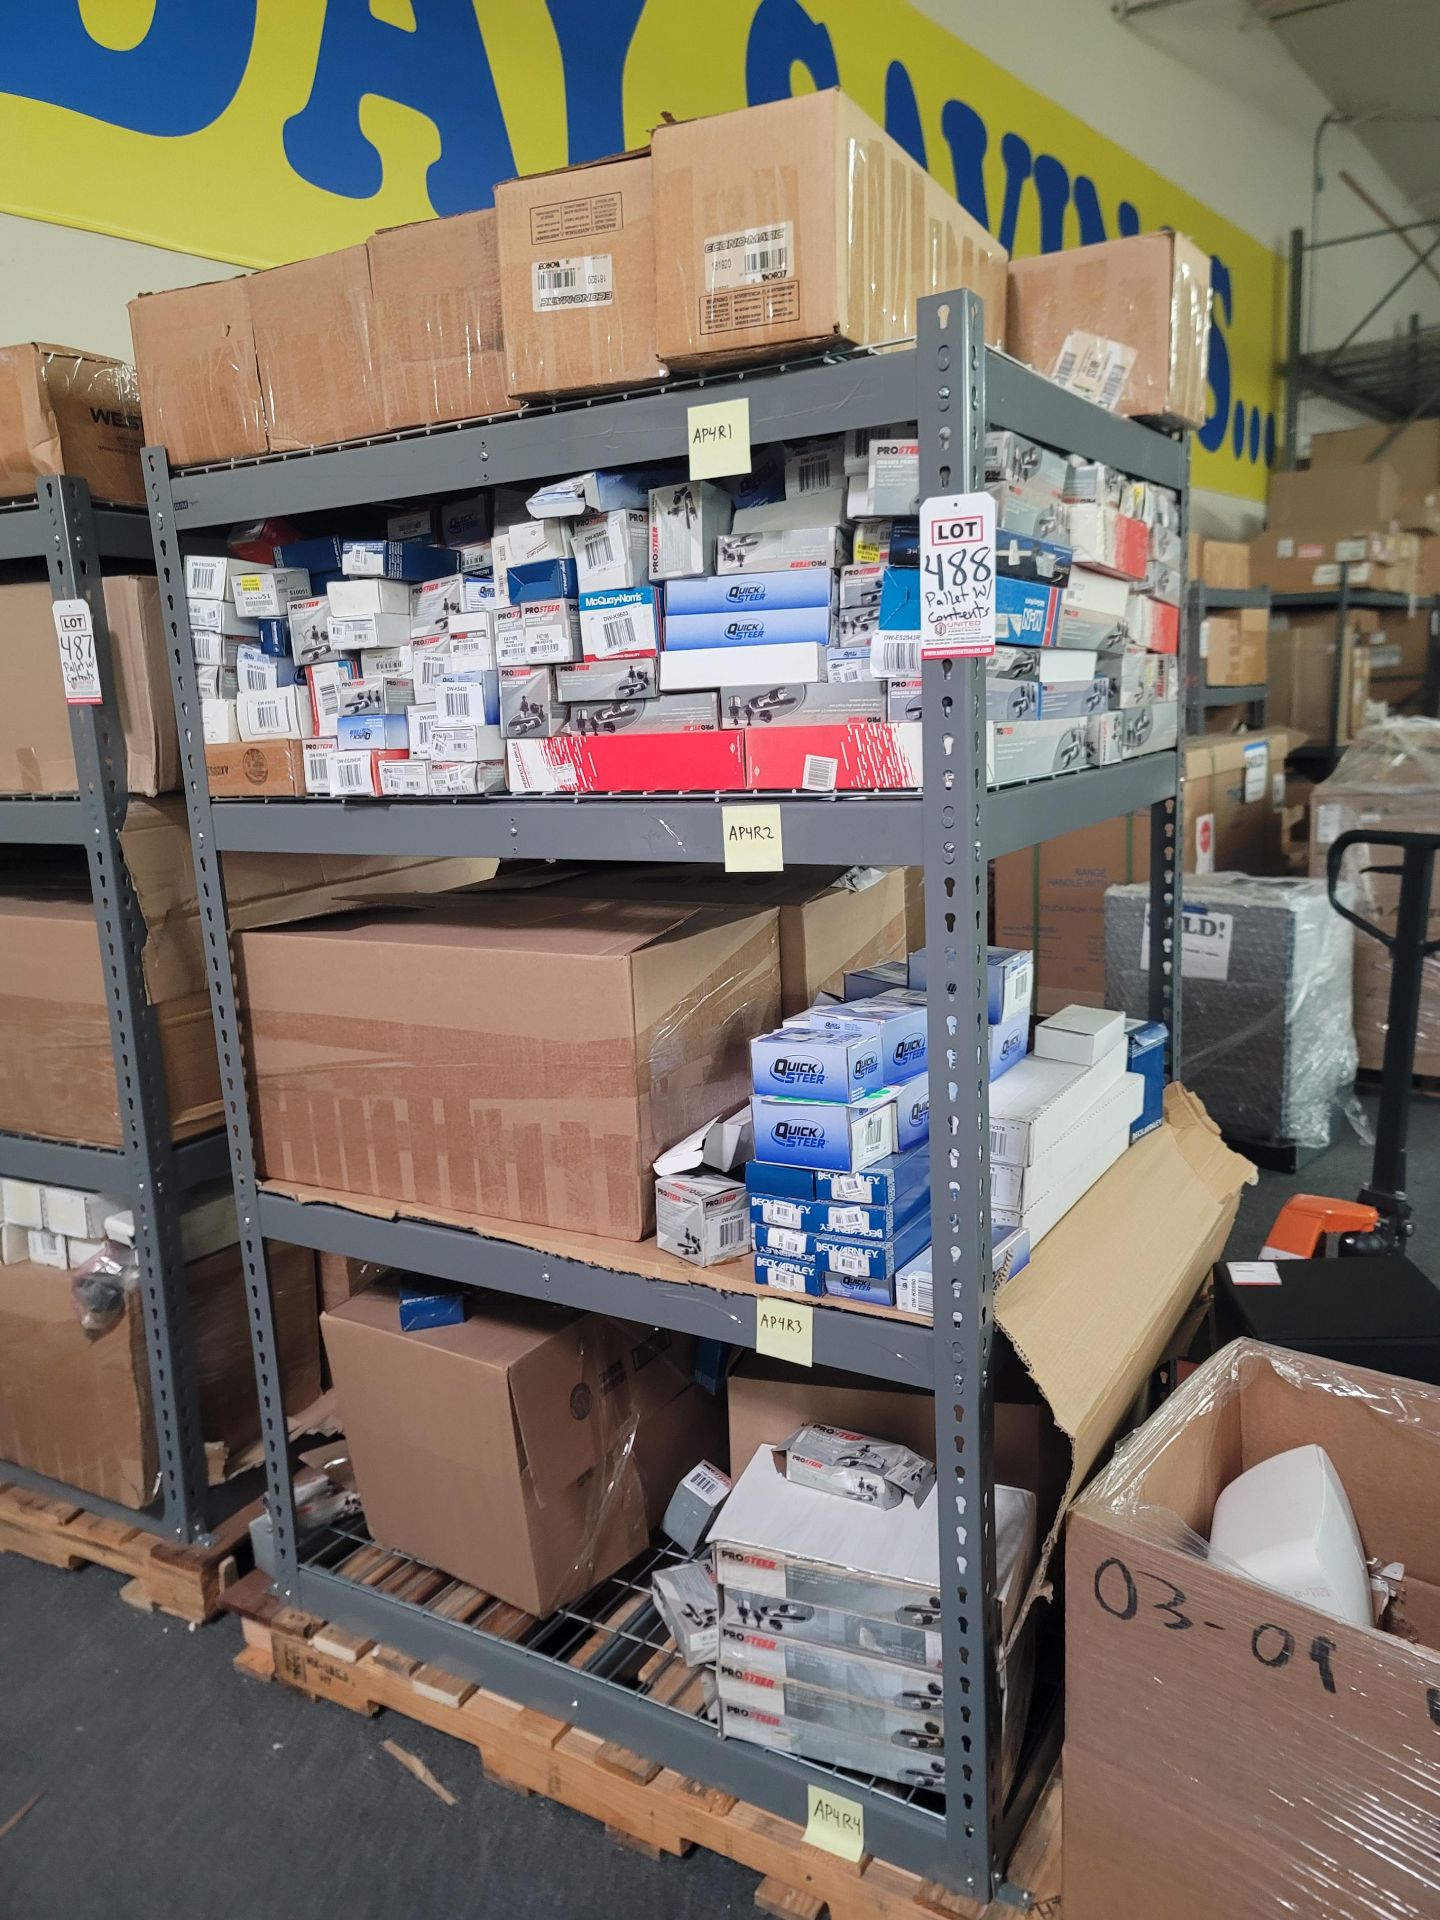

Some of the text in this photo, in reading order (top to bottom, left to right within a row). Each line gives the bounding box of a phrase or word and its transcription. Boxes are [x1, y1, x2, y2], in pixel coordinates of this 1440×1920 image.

[90, 407, 144, 430] WES
[693, 424, 732, 444] AP4R1
[876, 446, 919, 456] PROSTE
[938, 522, 978, 540] LOT
[790, 560, 827, 568] PROSTEER
[845, 566, 881, 576] PROSTEER
[924, 546, 992, 591] 488
[412, 584, 438, 594] PROSTEER
[728, 586, 760, 598] QUICK
[586, 592, 642, 606] McQuay-Norris
[738, 594, 766, 602] STEER
[925, 586, 969, 608] Pallet
[290, 600, 319, 611] PROSTEER
[525, 604, 560, 614] PROSTEER
[928, 601, 990, 623] Contents
[498, 611, 521, 620] PROST
[64, 618, 82, 628] LOT
[727, 624, 760, 635] QUICK
[947, 620, 981, 628] UNITED
[736, 630, 764, 640] STEER
[60, 634, 92, 660] 487
[501, 669, 531, 677] PROSTEER
[729, 825, 774, 841] AP4R2
[896, 1040, 921, 1060] QUICK
[902, 1047, 927, 1064] STEER
[774, 1059, 818, 1075] QUICK
[854, 1055, 875, 1075] QUICK
[861, 1063, 878, 1077] STEER
[784, 1072, 825, 1084] STEER
[775, 1122, 818, 1139] QUICK
[786, 1136, 825, 1149] STEER
[658, 1188, 681, 1202] PROSTEER
[706, 1194, 737, 1208] PROSTEER
[816, 1242, 879, 1258] BECK/ARNLEY
[756, 1256, 815, 1276] BECK/ARNLEY
[843, 1276, 868, 1286] QUICK
[849, 1283, 872, 1292] STEER
[760, 1314, 802, 1333] AP4R3
[813, 1423, 864, 1441] PROSTEER
[792, 1455, 823, 1469] PROSTEER
[722, 1550, 776, 1570] PROSTEER
[723, 1628, 776, 1650] PROSTEER
[722, 1665, 775, 1688] PROSTEER
[727, 1705, 779, 1726] PROSTEER
[814, 1800, 861, 1836] AP4R4
